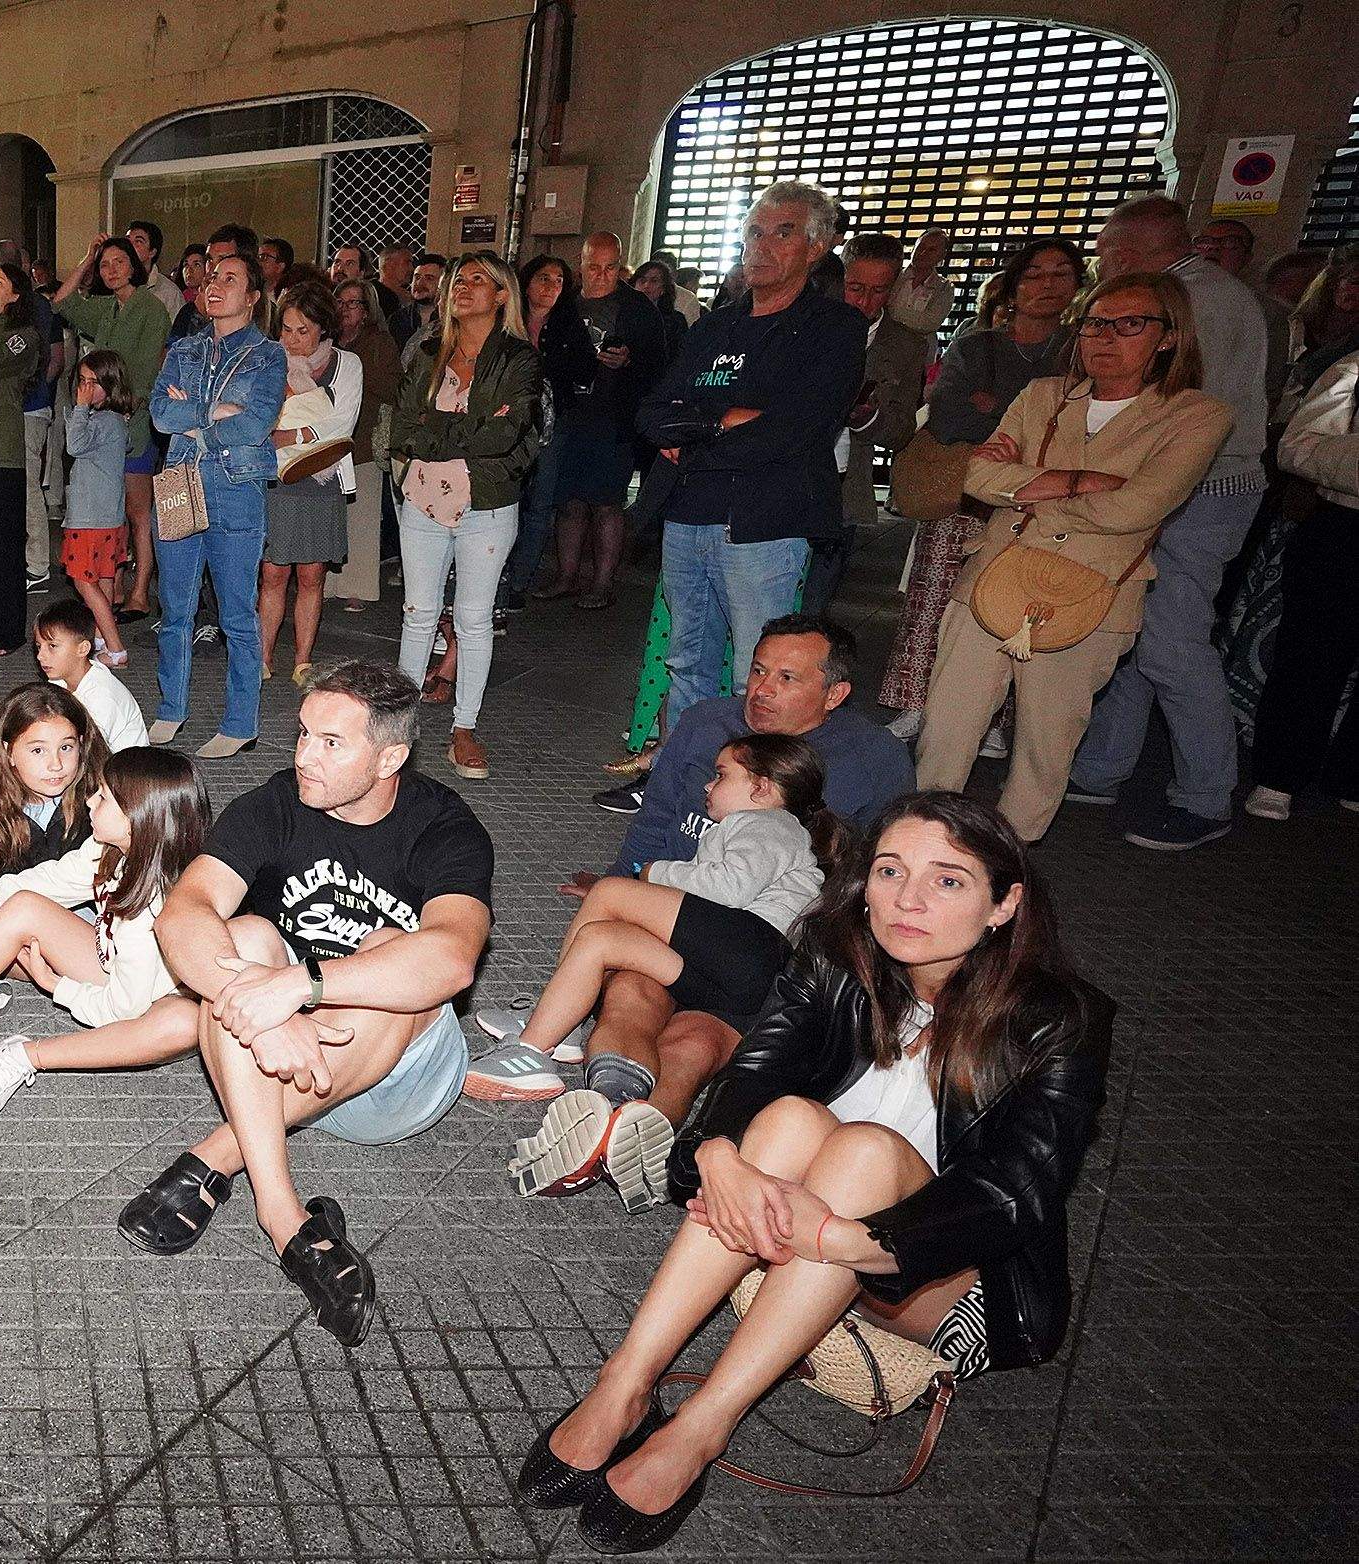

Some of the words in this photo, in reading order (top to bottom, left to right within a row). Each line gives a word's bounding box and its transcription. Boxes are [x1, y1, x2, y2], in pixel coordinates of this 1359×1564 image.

[1234, 190, 1265, 201] VAO
[160, 491, 188, 513] TOUS
[282, 858, 335, 909] JACK
[333, 889, 370, 914] DENIM
